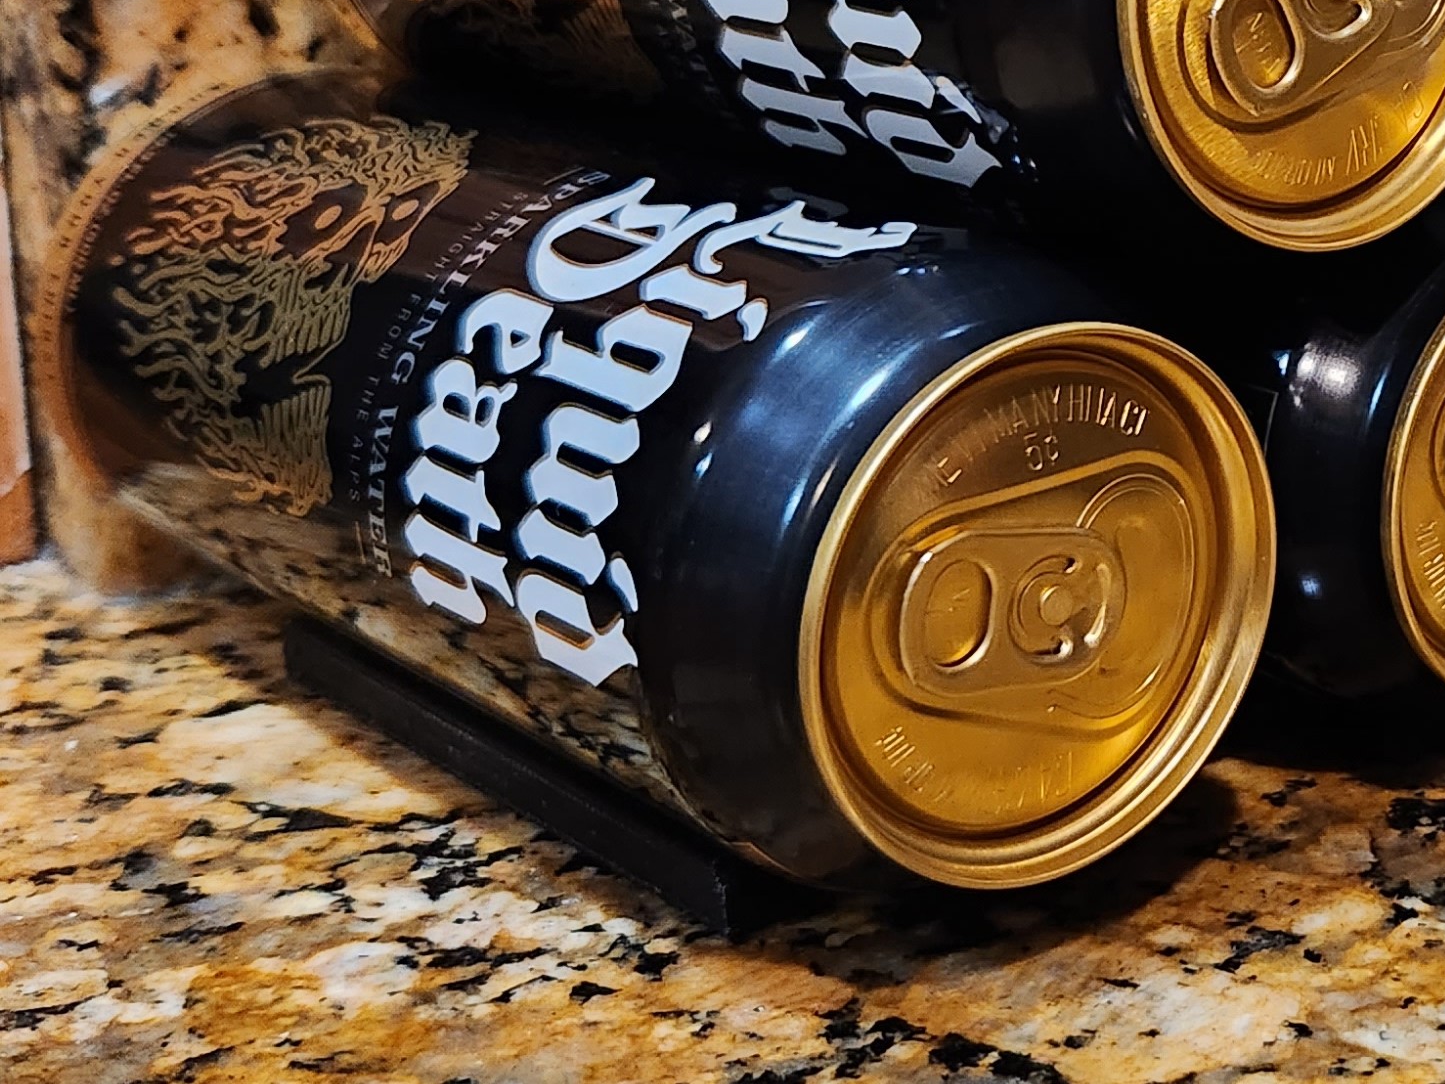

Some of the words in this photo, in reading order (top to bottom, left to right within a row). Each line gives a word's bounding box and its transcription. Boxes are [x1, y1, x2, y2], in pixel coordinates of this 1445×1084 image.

[391, 169, 612, 388] SPARKLING
[422, 192, 529, 289] STRAIGHT
[379, 291, 422, 362] FROM
[355, 375, 380, 425] THE
[404, 177, 737, 626] Death
[516, 200, 920, 687] Liquid
[348, 435, 364, 502] ALPS
[366, 403, 401, 578] WATER
